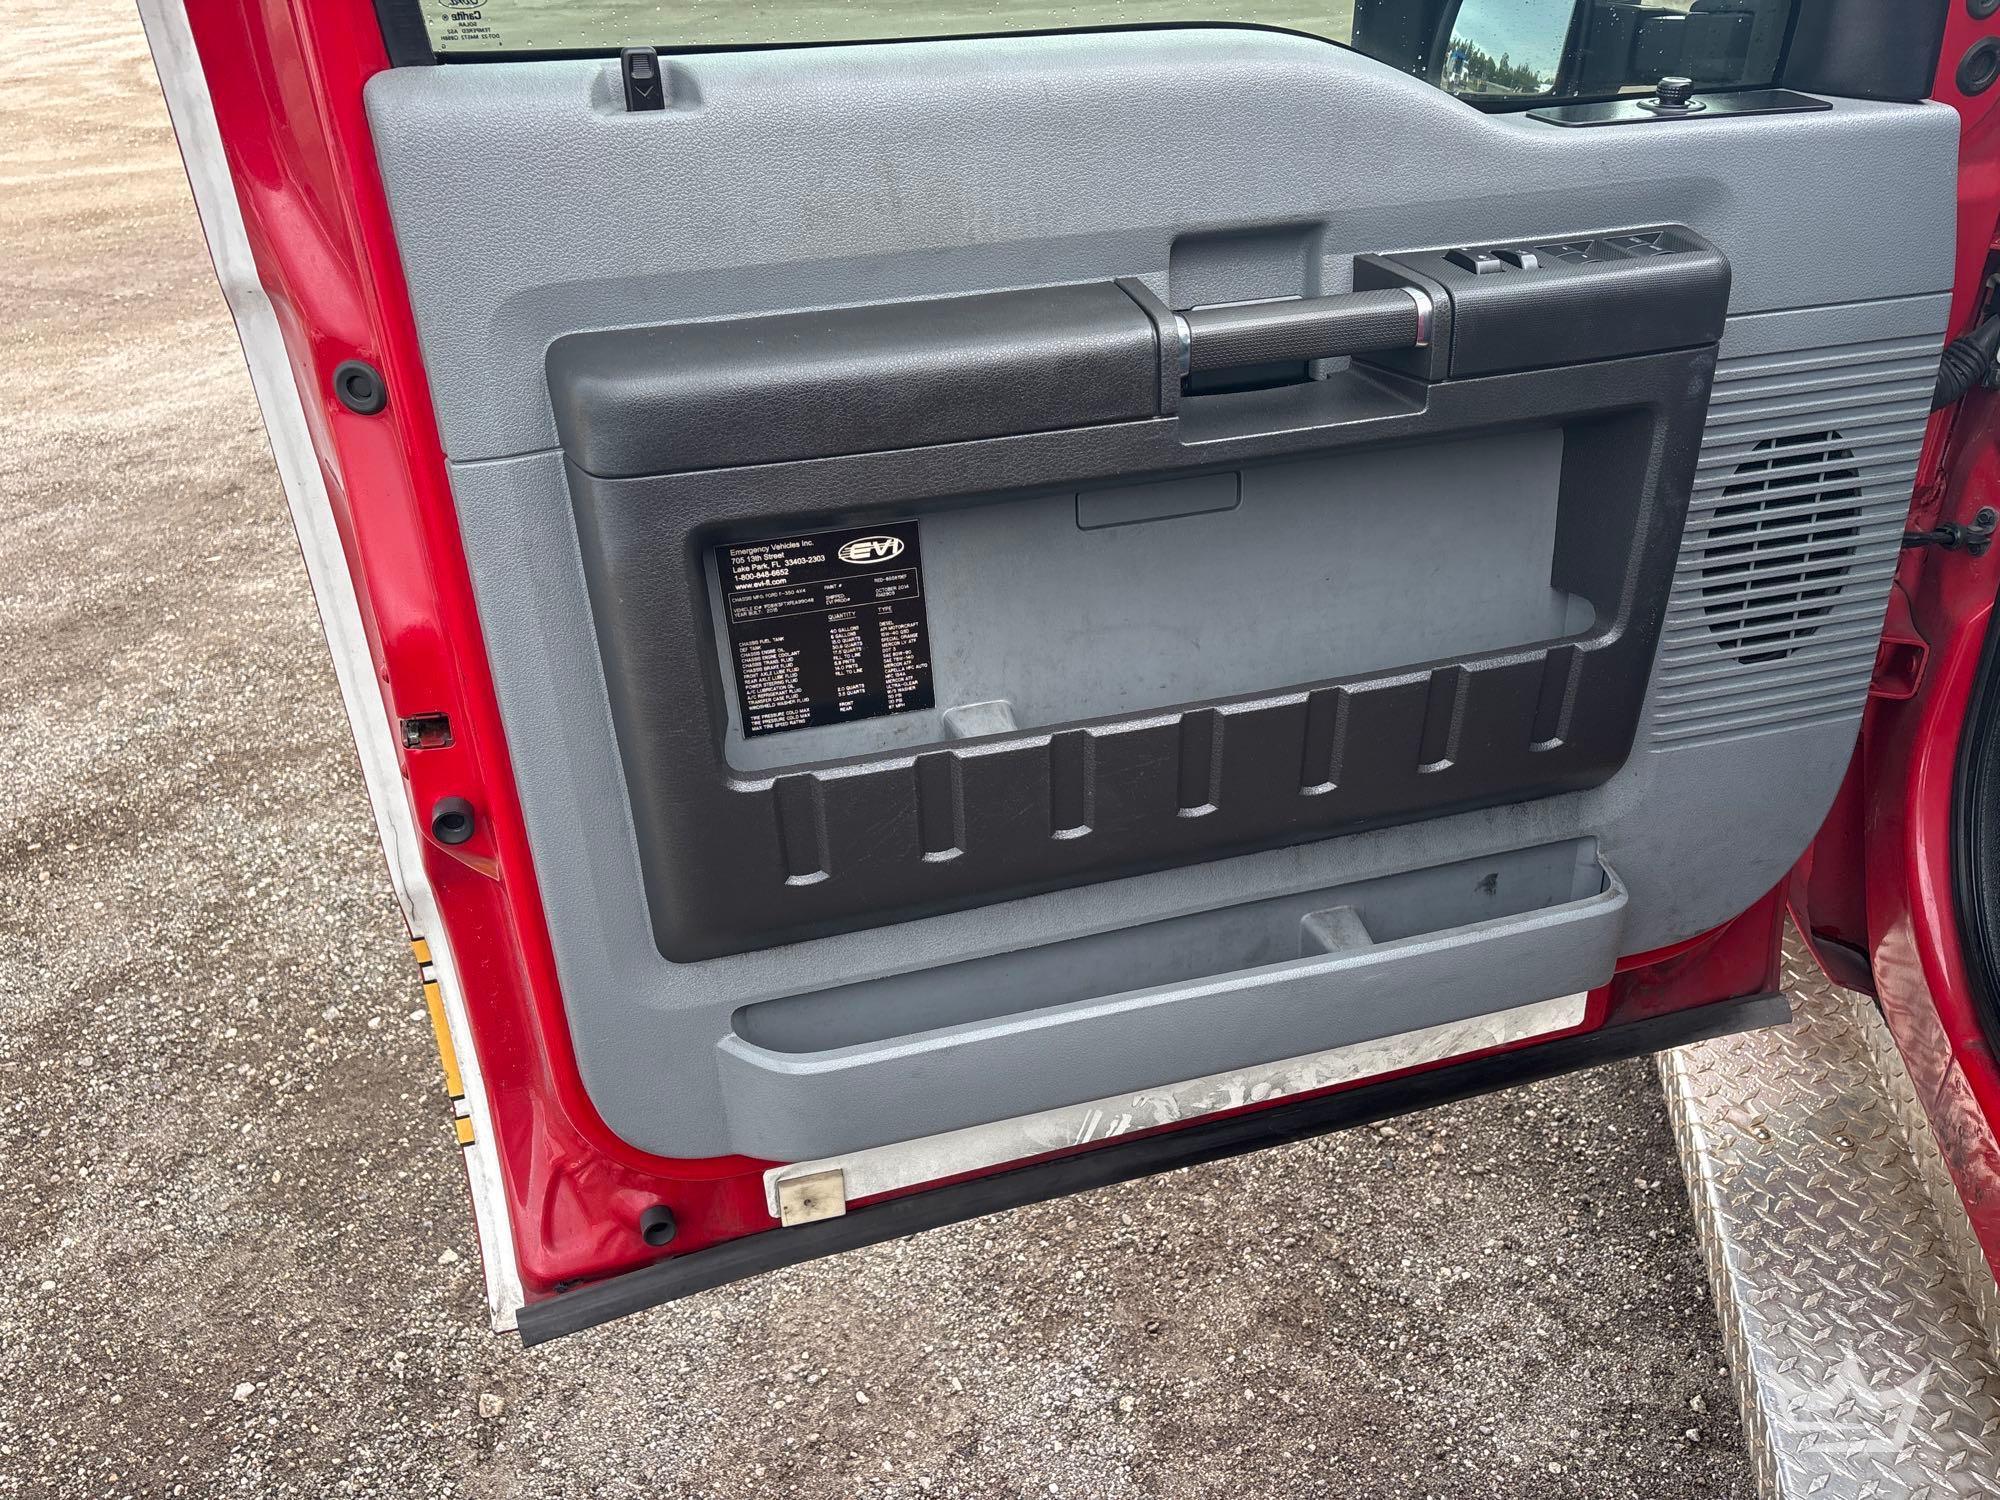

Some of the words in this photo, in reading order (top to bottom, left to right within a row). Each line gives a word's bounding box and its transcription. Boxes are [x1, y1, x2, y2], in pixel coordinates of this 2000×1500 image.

[730, 545, 769, 557] Emergency
[771, 542, 800, 551] Vehicles
[764, 552, 784, 560] Street
[752, 563, 770, 571] Park,
[784, 555, 825, 566] 33403-2303
[734, 569, 789, 582] 1-800-848-6652
[828, 611, 856, 620] QUANTITY
[888, 622, 919, 630] MOTORCRAFT
[757, 685, 786, 693] LUBRICATION
[886, 680, 918, 689] ULTRA-CLEAR
